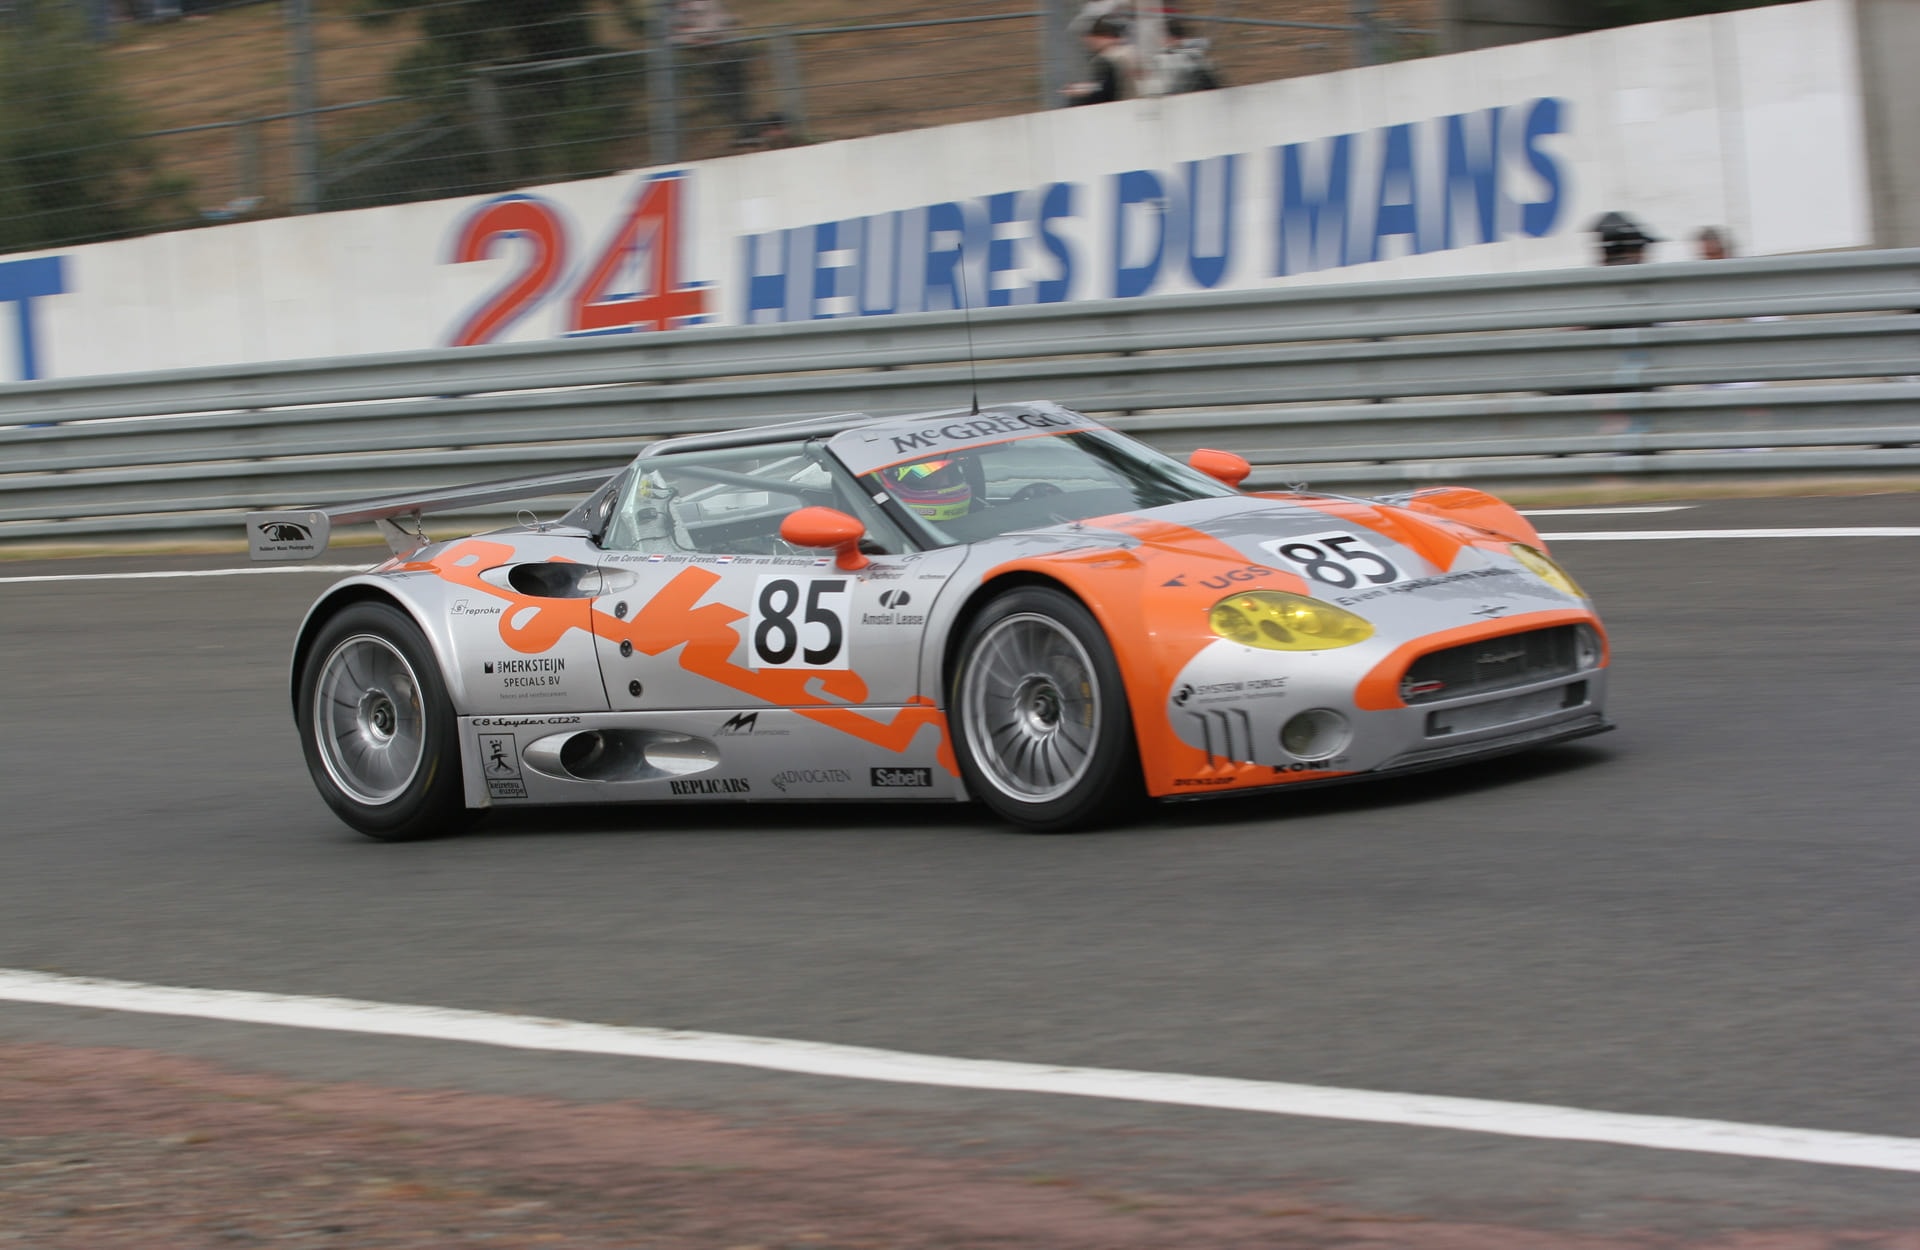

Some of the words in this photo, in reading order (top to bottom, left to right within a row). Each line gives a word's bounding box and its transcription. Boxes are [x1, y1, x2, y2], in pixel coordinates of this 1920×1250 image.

[448, 170, 714, 346] 24
[742, 182, 1078, 324] HEURES
[1108, 154, 1237, 298] DU
[1272, 97, 1566, 278] MANS
[605, 554, 620, 562] Tom
[732, 556, 754, 565] Peter
[1278, 536, 1398, 589] 85
[1199, 565, 1273, 589] UGS
[465, 606, 501, 616] reproka
[755, 578, 848, 665] 85
[861, 613, 894, 625] Amstel
[896, 613, 924, 625] Lease
[503, 658, 565, 673] MERKSTEIJN
[504, 676, 546, 687] SPECIALS
[548, 676, 561, 686] BV
[1197, 681, 1244, 696] SYSTEM
[1246, 678, 1288, 690] FORCE
[472, 718, 490, 727] C8
[492, 717, 546, 728] Spyder
[1274, 760, 1330, 774] KONI
[781, 769, 853, 785] ADVOCATEN
[875, 768, 928, 787] Sabelt
[670, 777, 751, 796] REPLICARS
